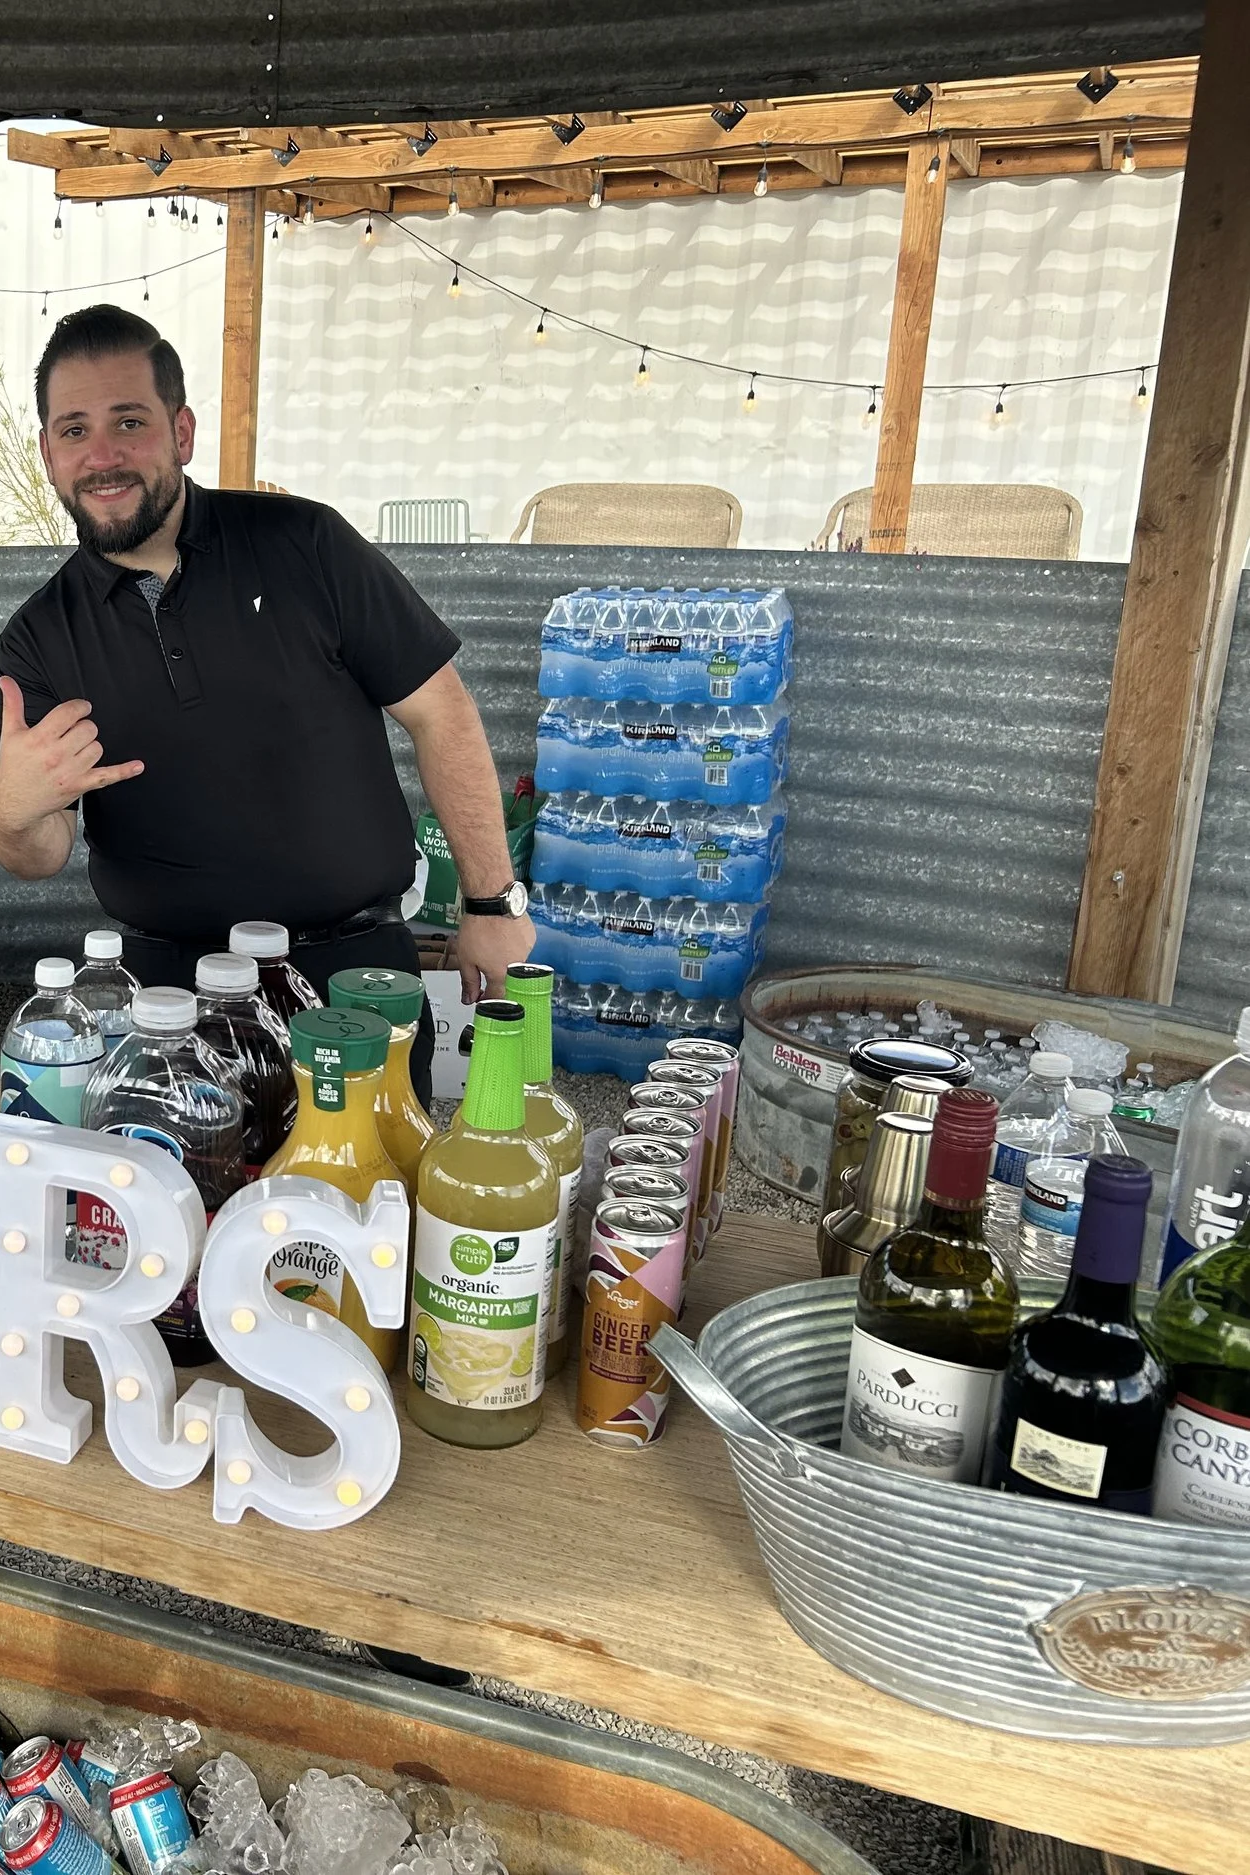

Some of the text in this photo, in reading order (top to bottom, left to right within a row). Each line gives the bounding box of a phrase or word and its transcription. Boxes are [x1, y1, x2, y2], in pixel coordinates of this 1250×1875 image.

[630, 637, 680, 648] KIRKLAND
[712, 655, 726, 664] 40
[710, 666, 736, 675] BOTTLES
[625, 725, 676, 737] KIRKLAND
[707, 744, 721, 752] 40
[704, 753, 732, 761] BOTTLES
[605, 918, 654, 932] KIRKLAND
[600, 1010, 649, 1023] KIRKLAND
[316, 1047, 331, 1055] RICH
[315, 1054, 341, 1064] VITAMIN
[776, 1044, 822, 1073] Behlen
[324, 1063, 332, 1073] C
[774, 1057, 821, 1082] COUNTRY
[318, 1087, 339, 1096] ADDED
[323, 1082, 332, 1090] NO
[318, 1093, 339, 1103] SUGAR
[456, 1244, 489, 1257] simple
[272, 1247, 338, 1279] Orange
[456, 1253, 487, 1265] truth
[441, 1274, 500, 1295] organic
[429, 1287, 512, 1317] MARGARITA
[606, 1290, 640, 1310] Kroger
[456, 1313, 477, 1325] MIX
[594, 1312, 650, 1339] GINGER
[592, 1327, 649, 1357] BEER
[857, 1369, 959, 1418] PARDUCCI
[1105, 1648, 1216, 1672] GARDEN
